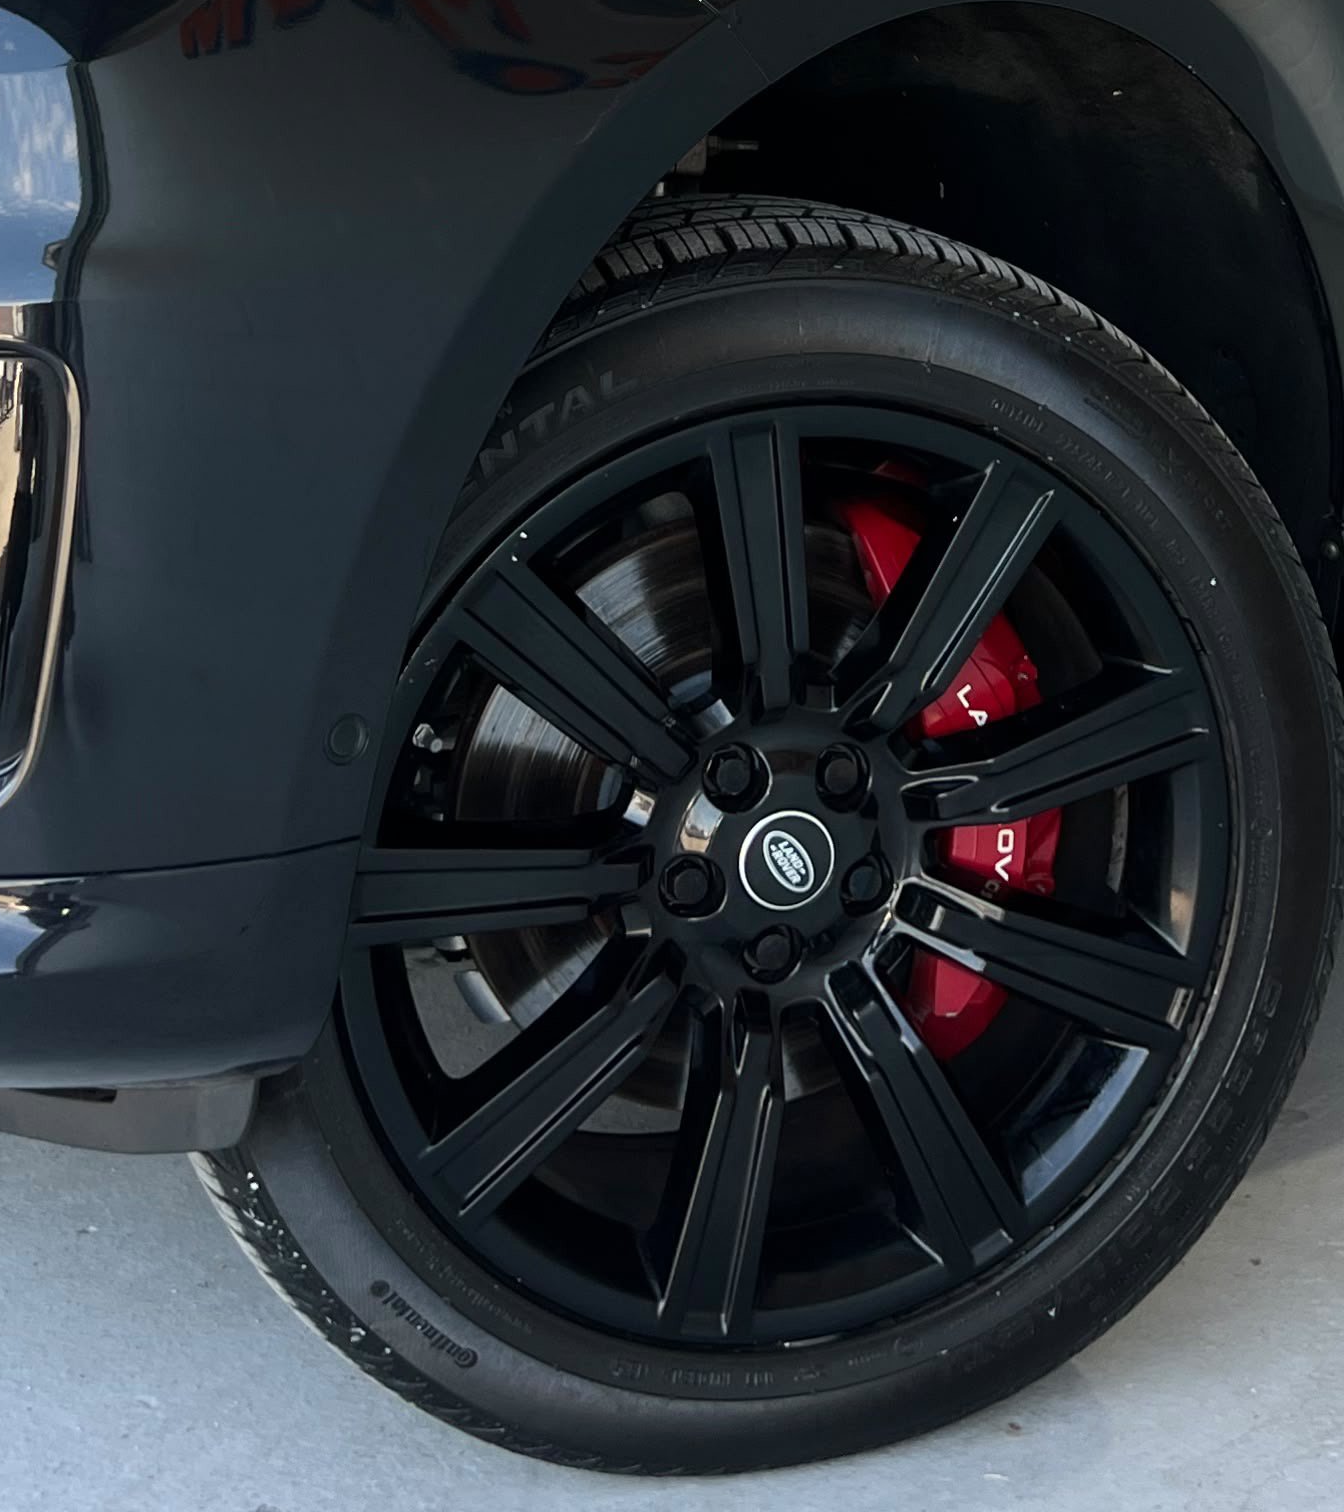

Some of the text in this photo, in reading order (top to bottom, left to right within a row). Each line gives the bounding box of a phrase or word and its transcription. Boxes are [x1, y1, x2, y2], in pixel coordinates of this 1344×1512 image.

[956, 683, 989, 727] LA
[771, 849, 802, 885] ROVER
[777, 840, 804, 869] LAND
